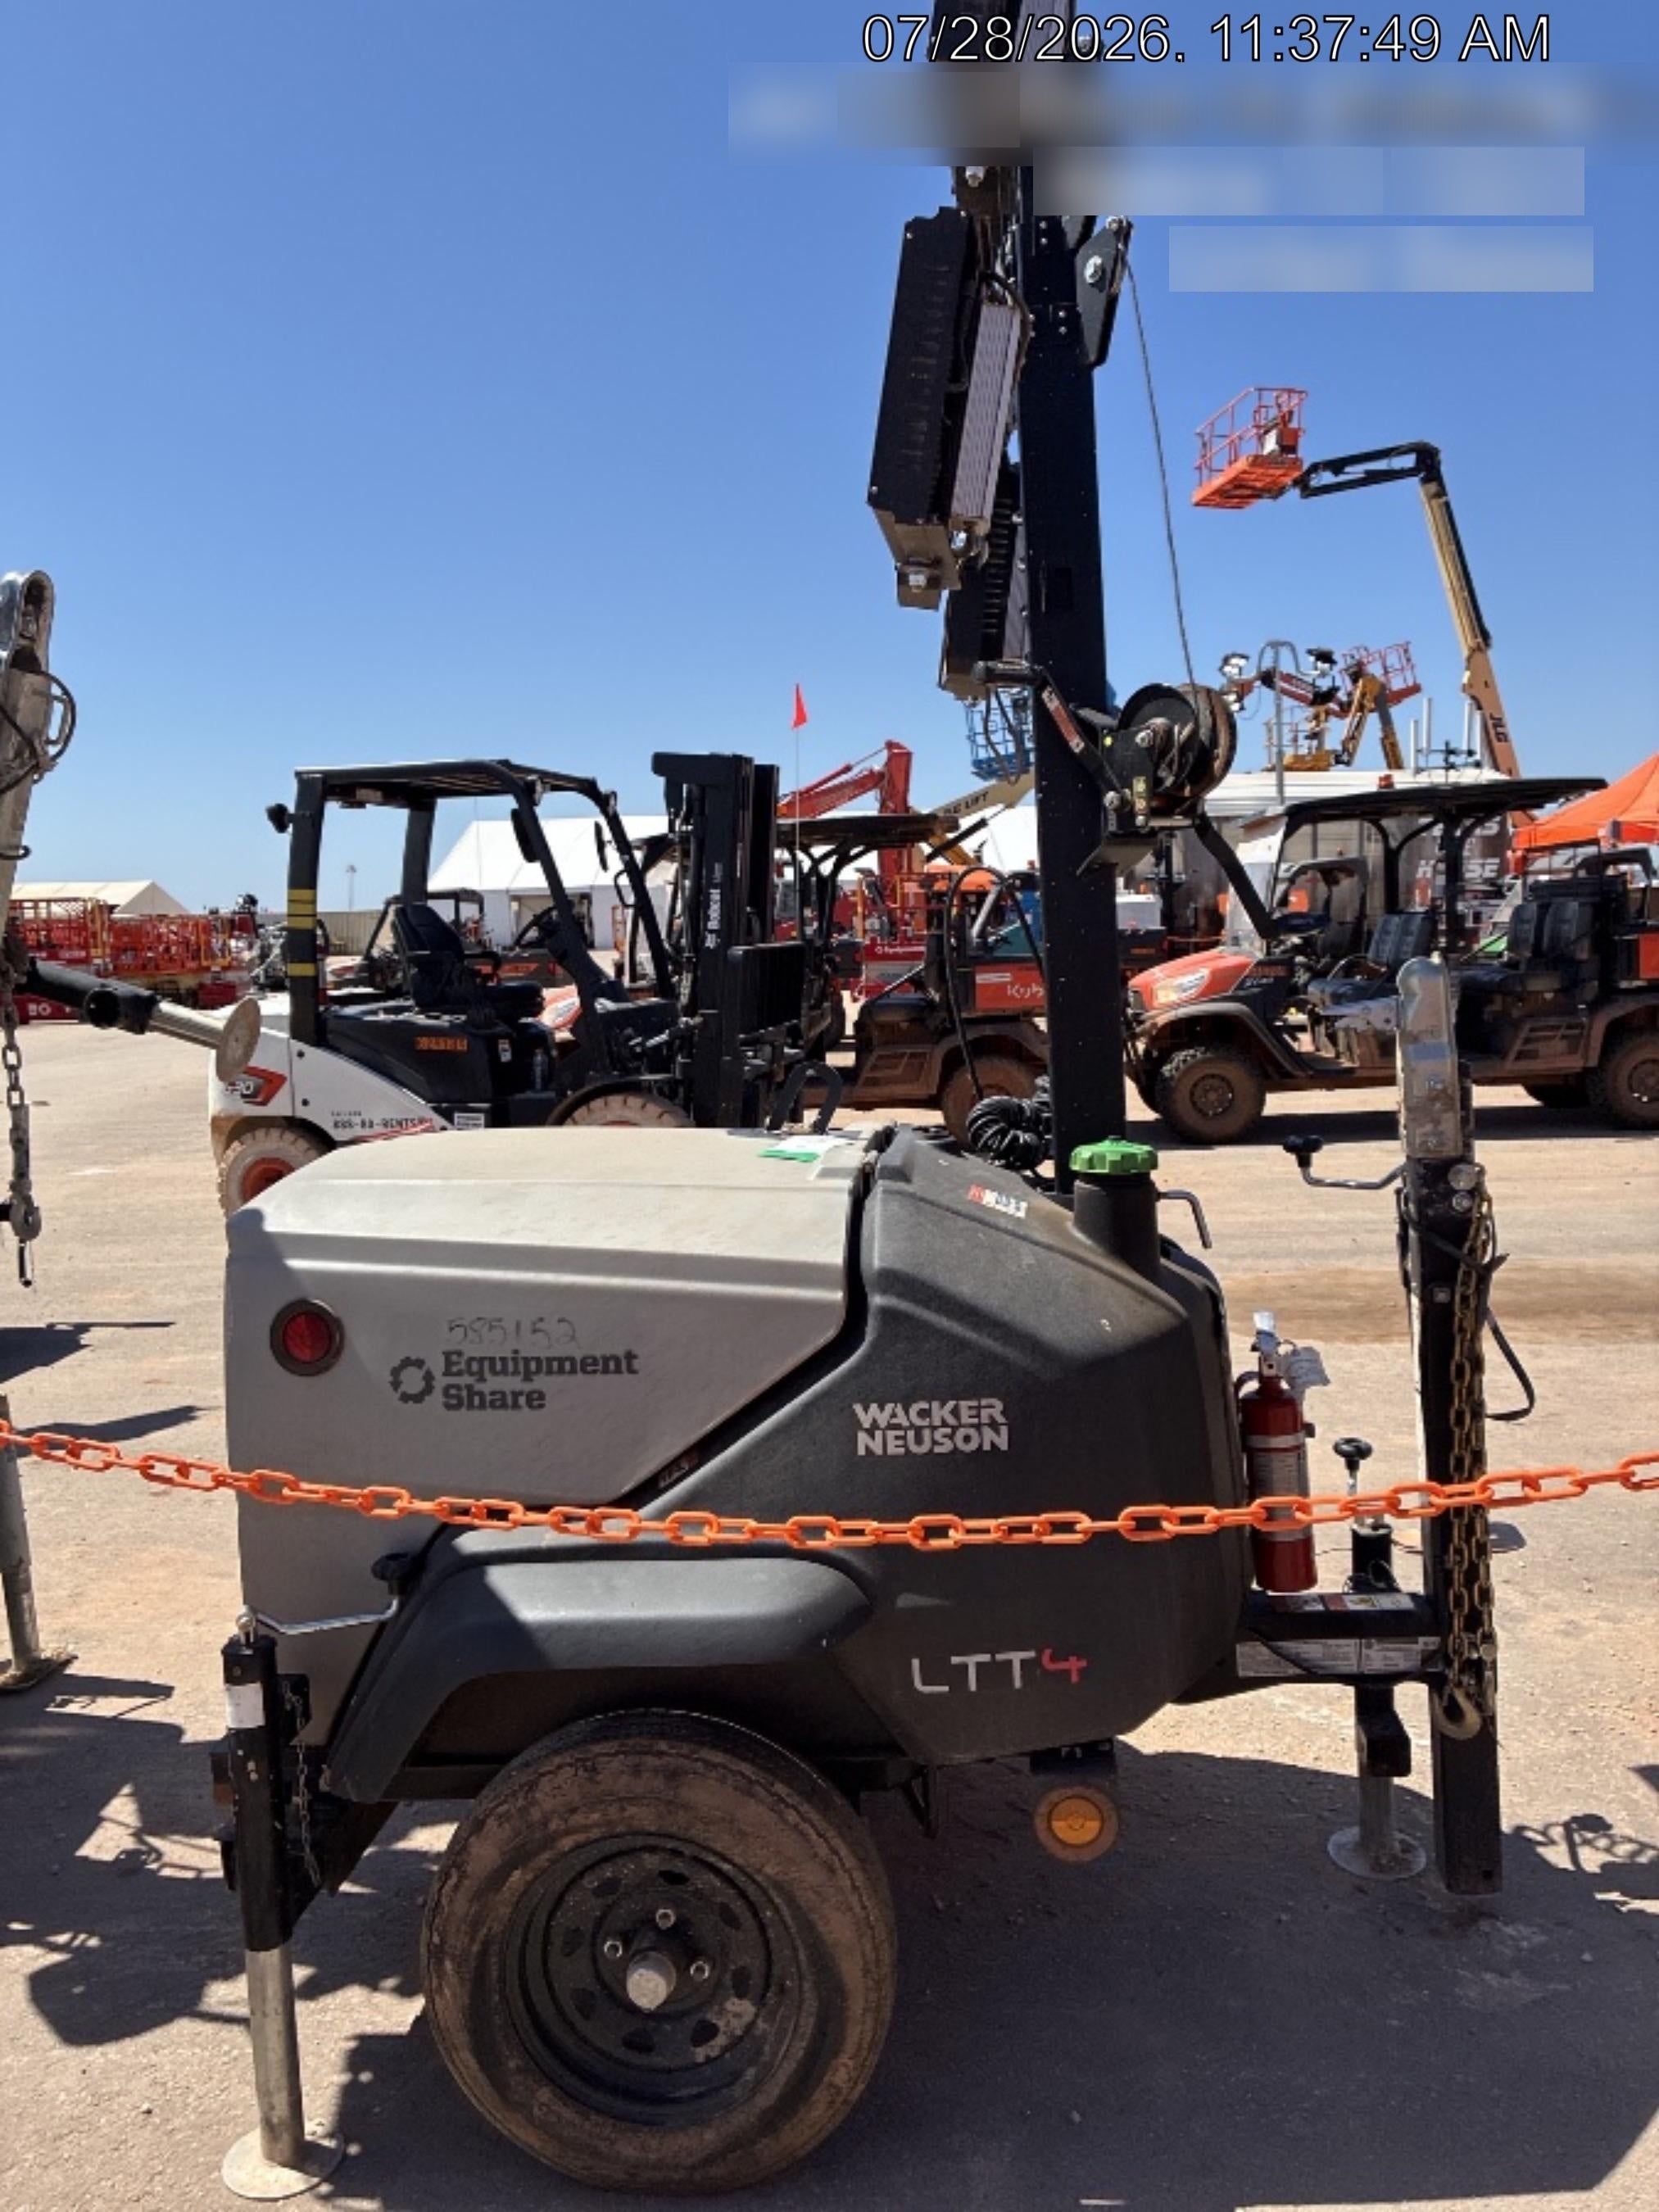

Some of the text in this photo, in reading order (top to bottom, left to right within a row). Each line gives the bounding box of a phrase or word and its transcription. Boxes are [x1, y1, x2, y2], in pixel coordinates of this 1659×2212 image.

[442, 1349, 639, 1383] Equipment
[442, 1383, 546, 1411] Share
[852, 1398, 1009, 1429] WACKER
[857, 1426, 1009, 1456] NEUSON
[911, 1648, 1088, 1693] LTT4
